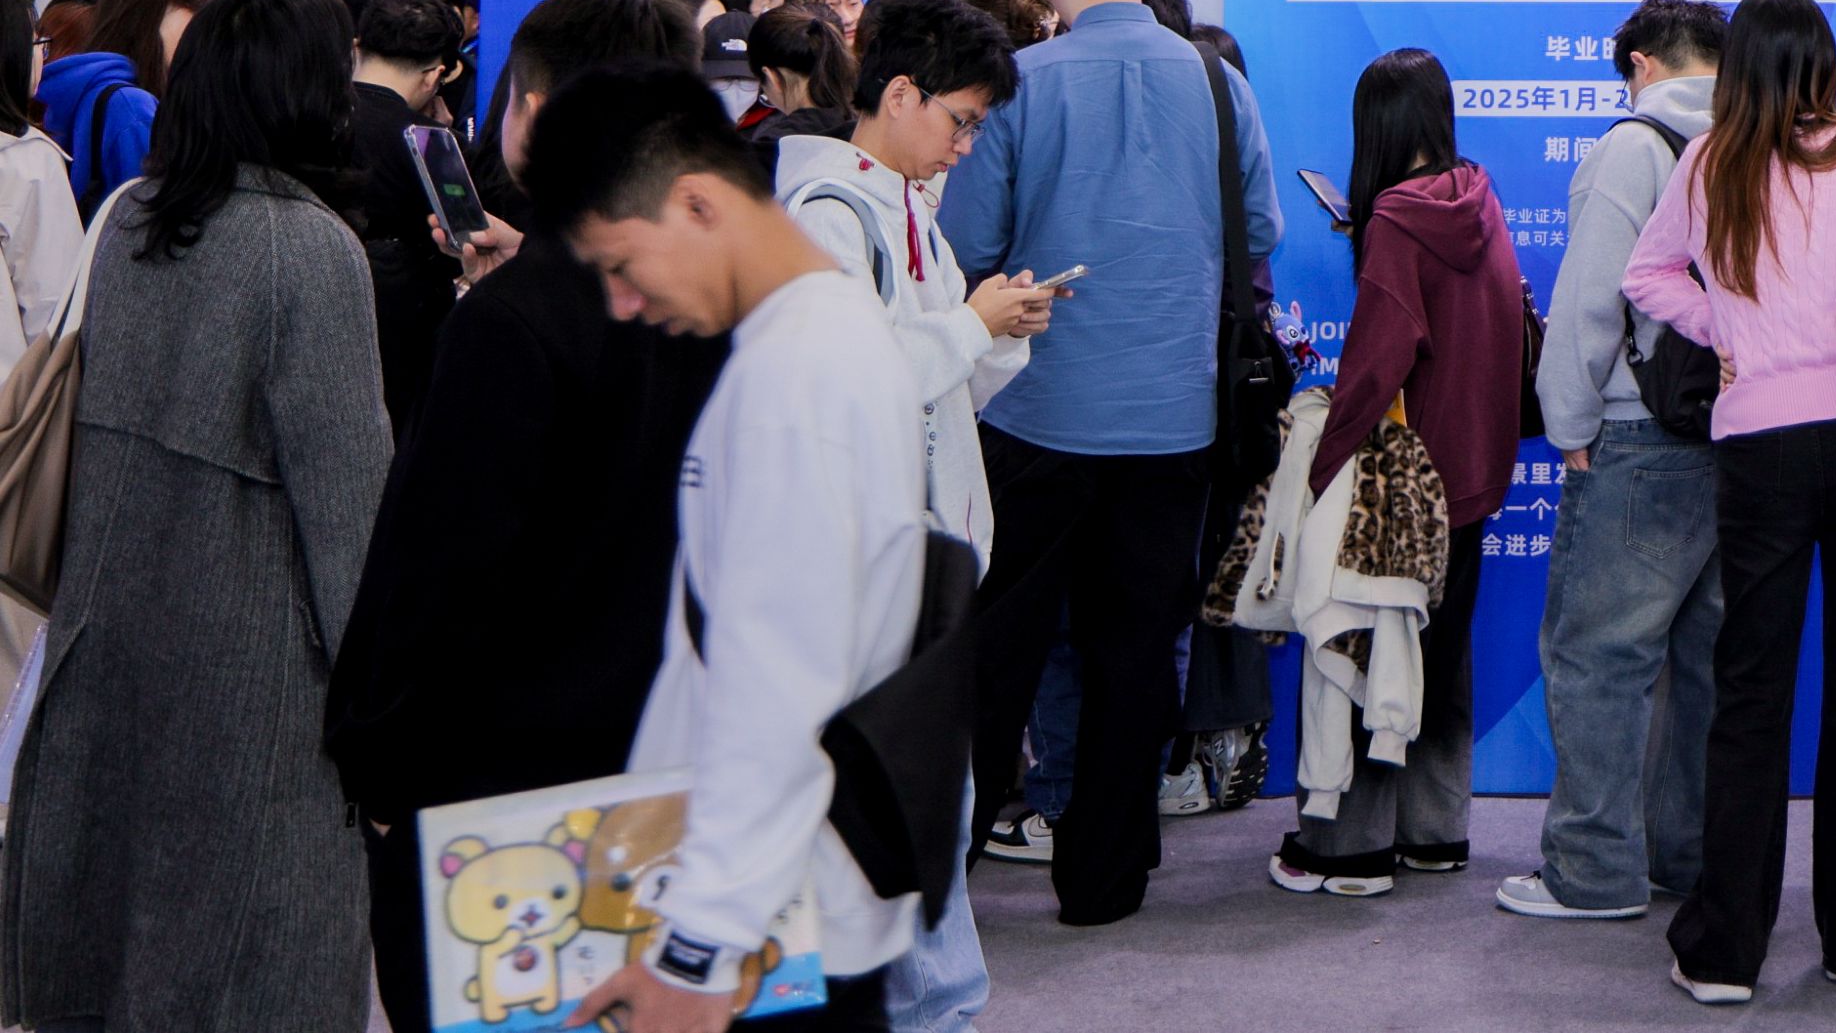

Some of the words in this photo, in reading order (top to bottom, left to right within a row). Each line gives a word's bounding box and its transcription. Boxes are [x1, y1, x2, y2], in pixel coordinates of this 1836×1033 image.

[1310, 321, 1352, 344] JOI
[1482, 533, 1552, 557] 会进步
